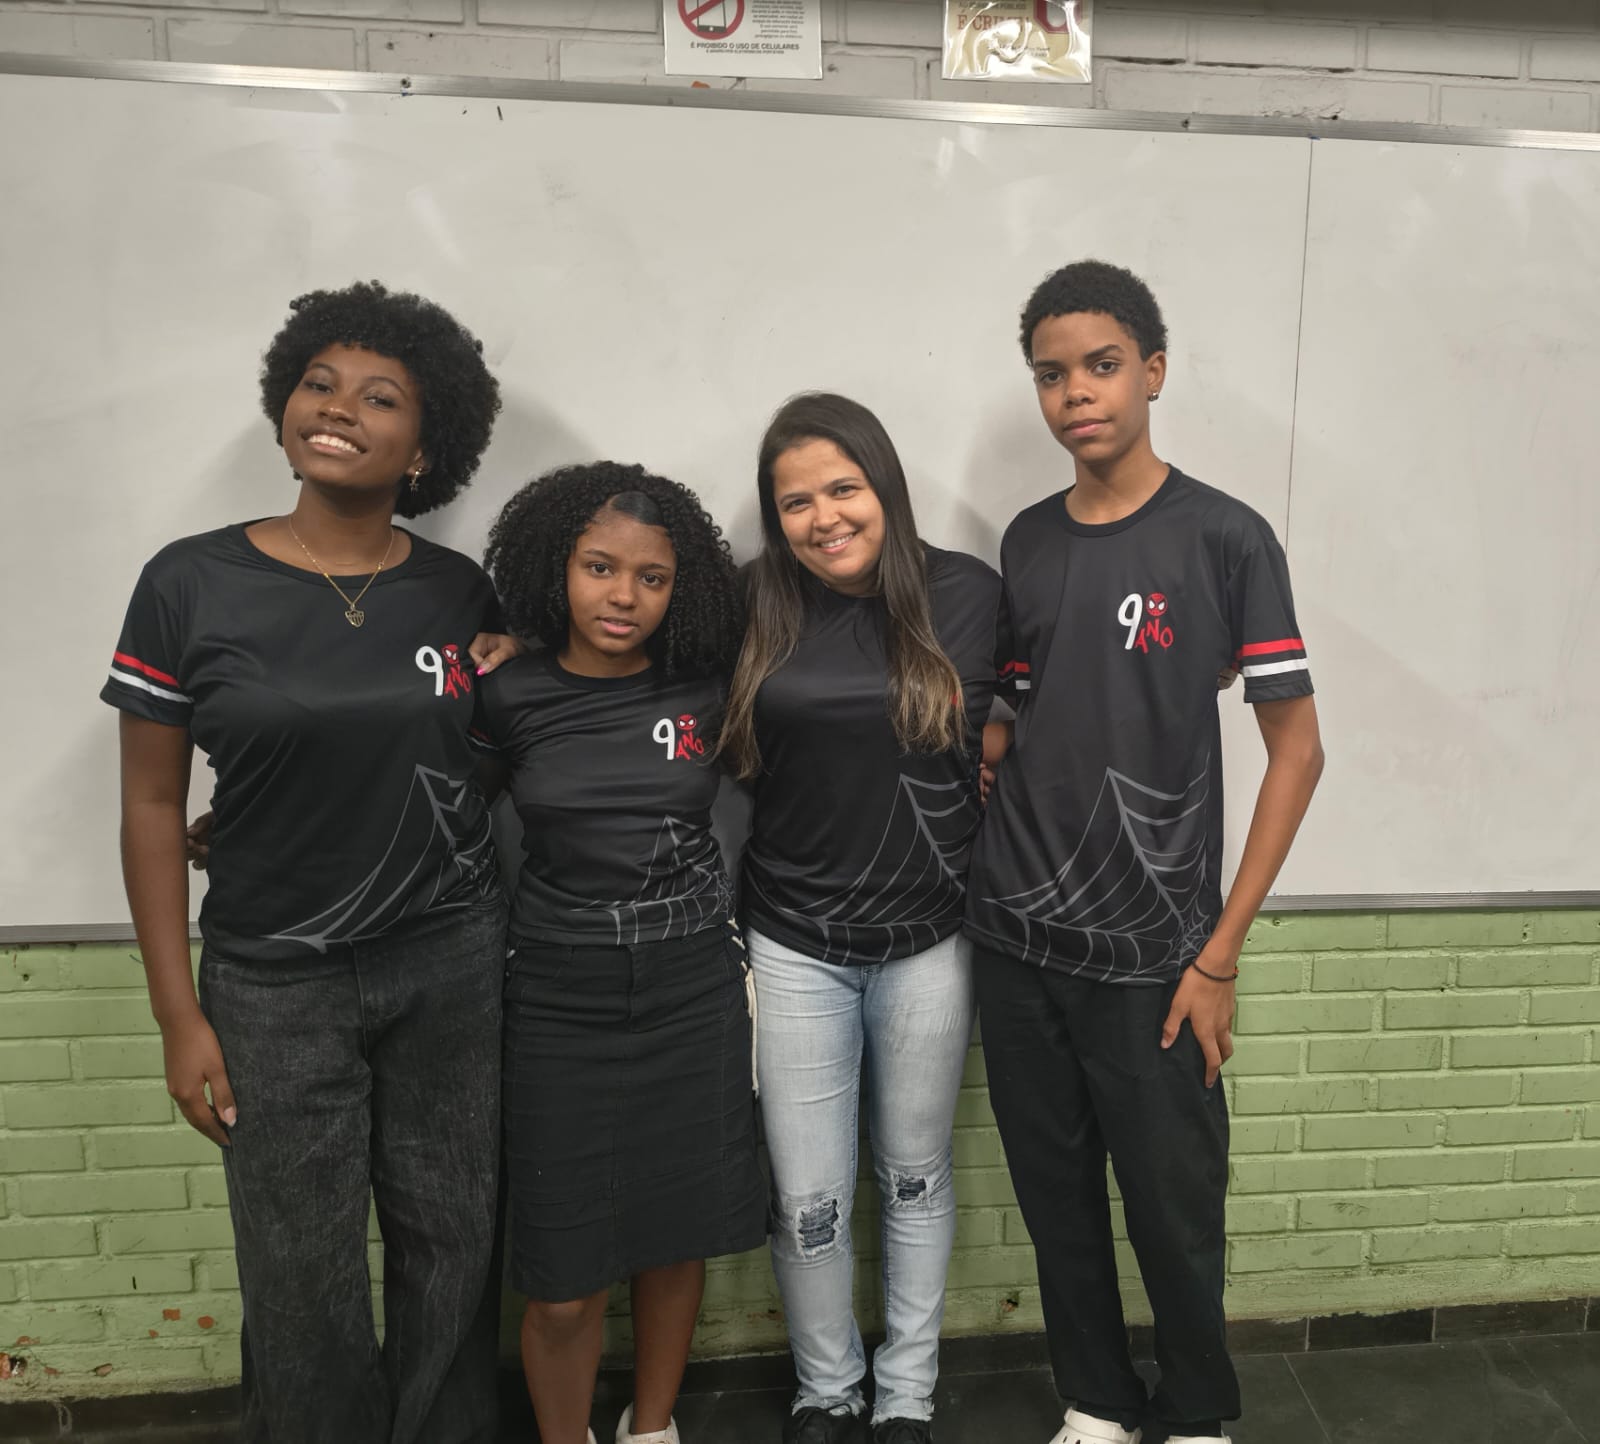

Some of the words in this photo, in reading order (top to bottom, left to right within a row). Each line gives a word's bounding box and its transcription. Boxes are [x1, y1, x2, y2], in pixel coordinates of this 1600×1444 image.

[957, 8, 967, 31] É
[690, 41, 695, 49] É
[761, 43, 800, 51] CELULARES
[1117, 592, 1143, 650] 9
[1134, 618, 1174, 654] ANO
[415, 645, 444, 697] 9
[444, 662, 472, 699] ANO
[652, 717, 675, 761] 9
[675, 730, 704, 761] ANO
